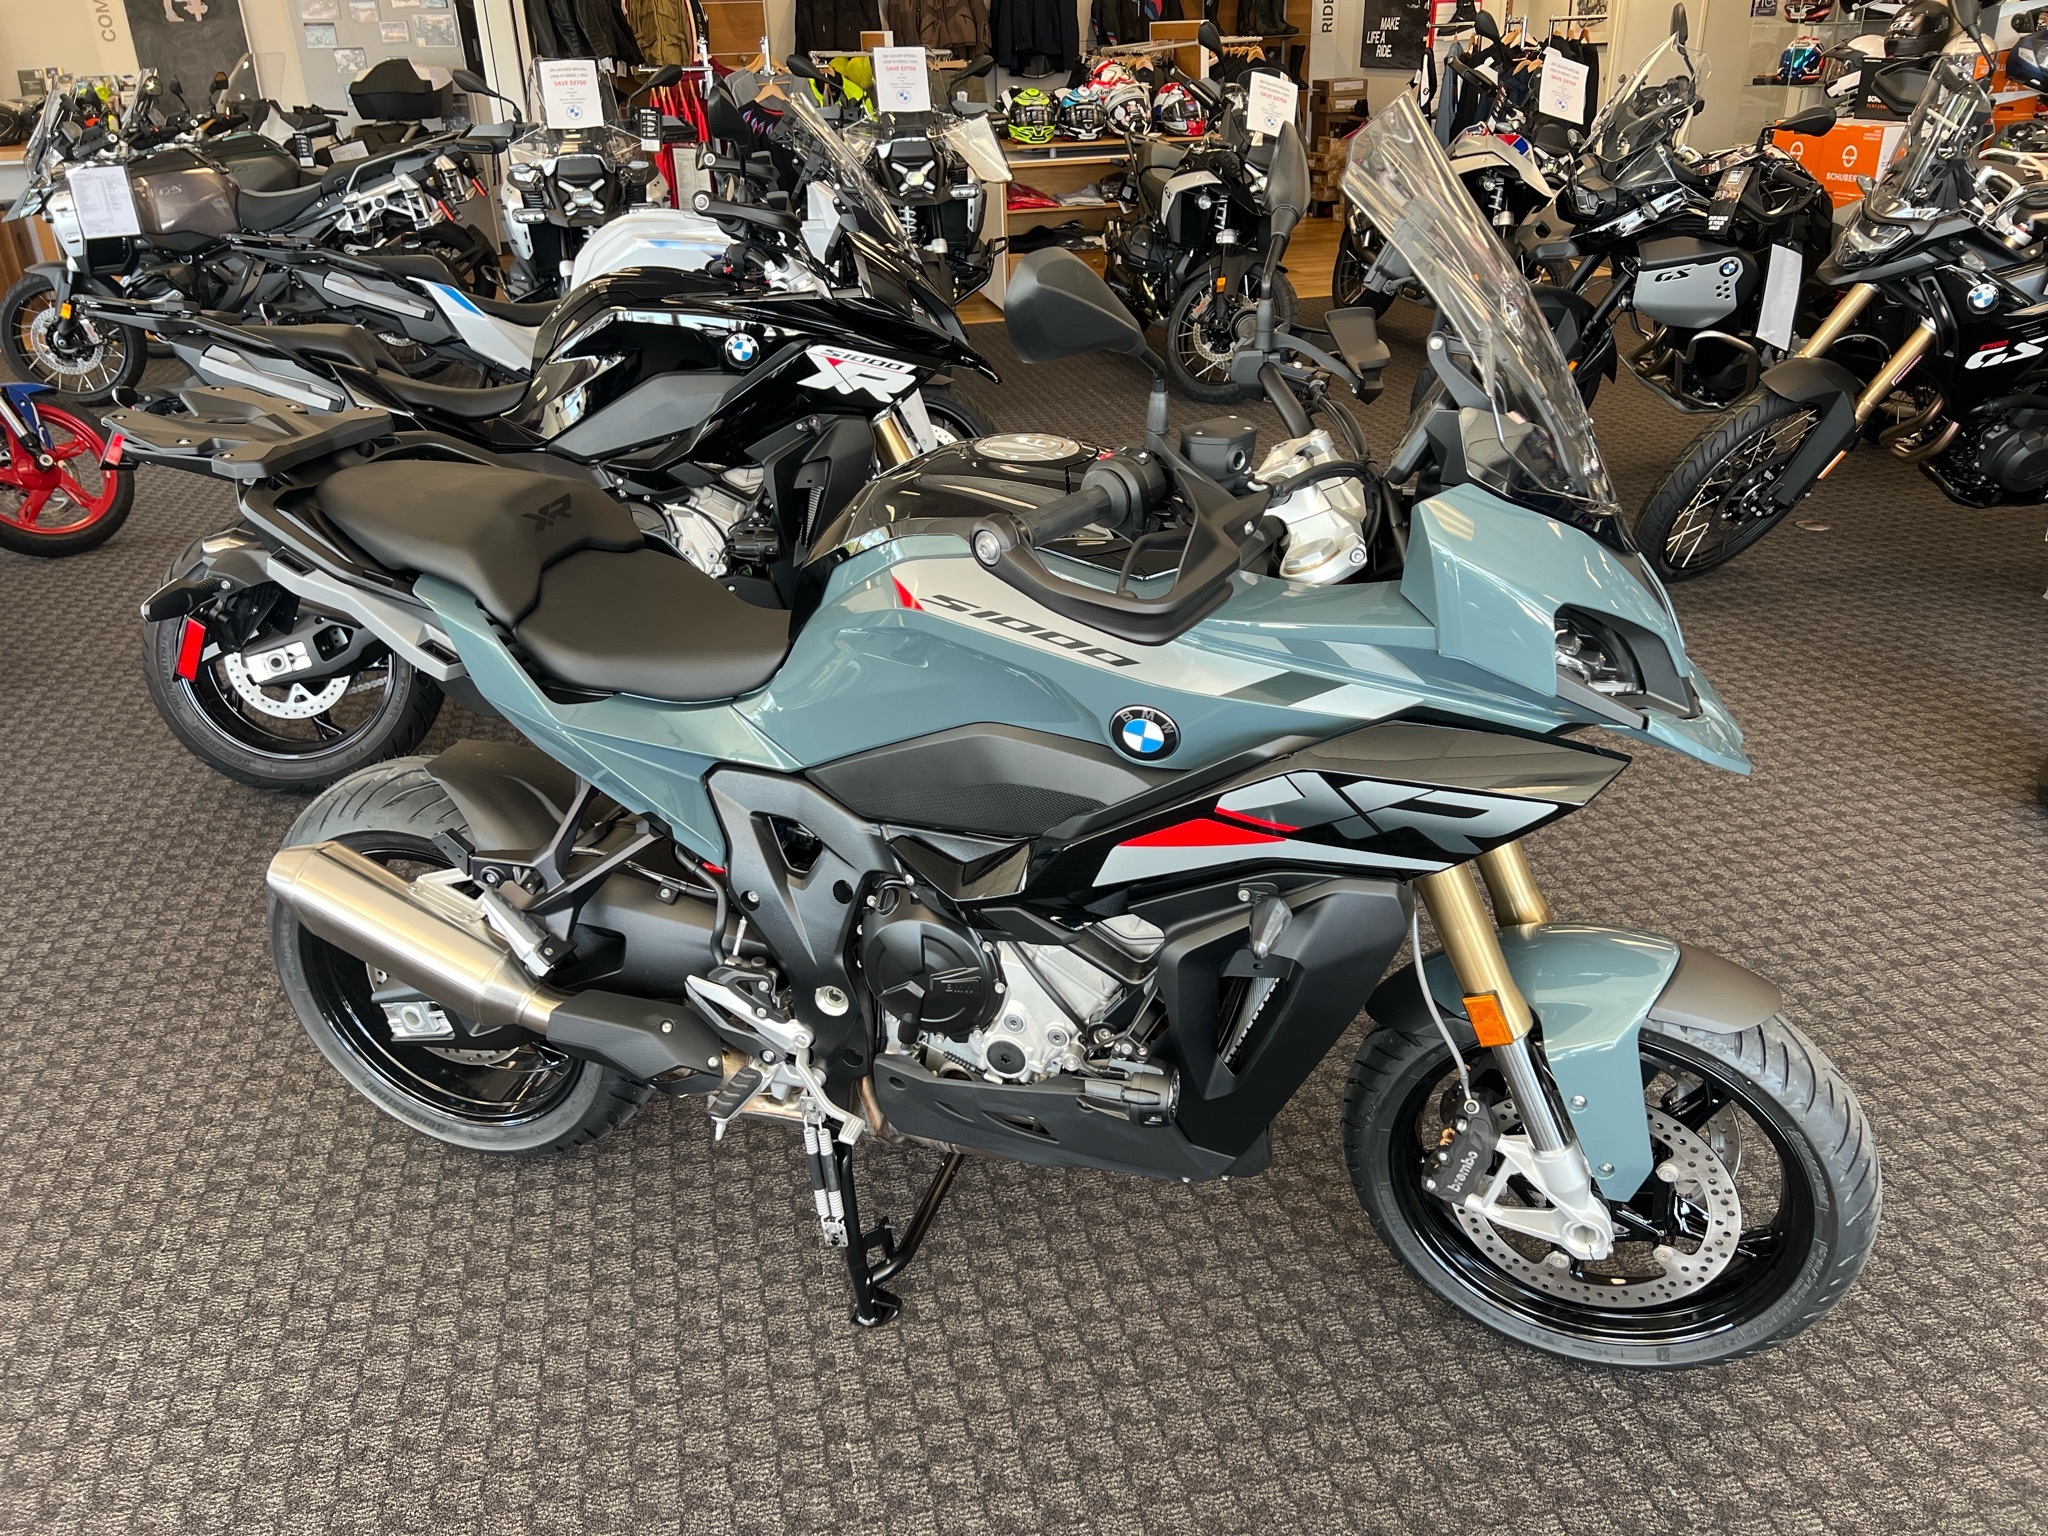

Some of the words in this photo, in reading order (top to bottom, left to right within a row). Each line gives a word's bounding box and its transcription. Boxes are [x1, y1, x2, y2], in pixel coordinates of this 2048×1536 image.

[1380, 17, 1400, 30] MAKE
[1367, 31, 1380, 43] LIFE
[1380, 31, 1385, 43] A
[1376, 45, 1392, 57] RIDE.
[1551, 74, 1562, 83] SAVE
[1563, 79, 1577, 87] $2750
[1260, 91, 1272, 99] SAVE
[1826, 172, 1858, 182] SCHUBER
[1654, 267, 1692, 282] GS
[819, 349, 904, 370] S1000
[1964, 335, 2048, 370] GS
[797, 352, 917, 403] XR
[520, 493, 573, 534] XR
[919, 594, 1141, 667] S1000
[1447, 1150, 1479, 1193] brembo
